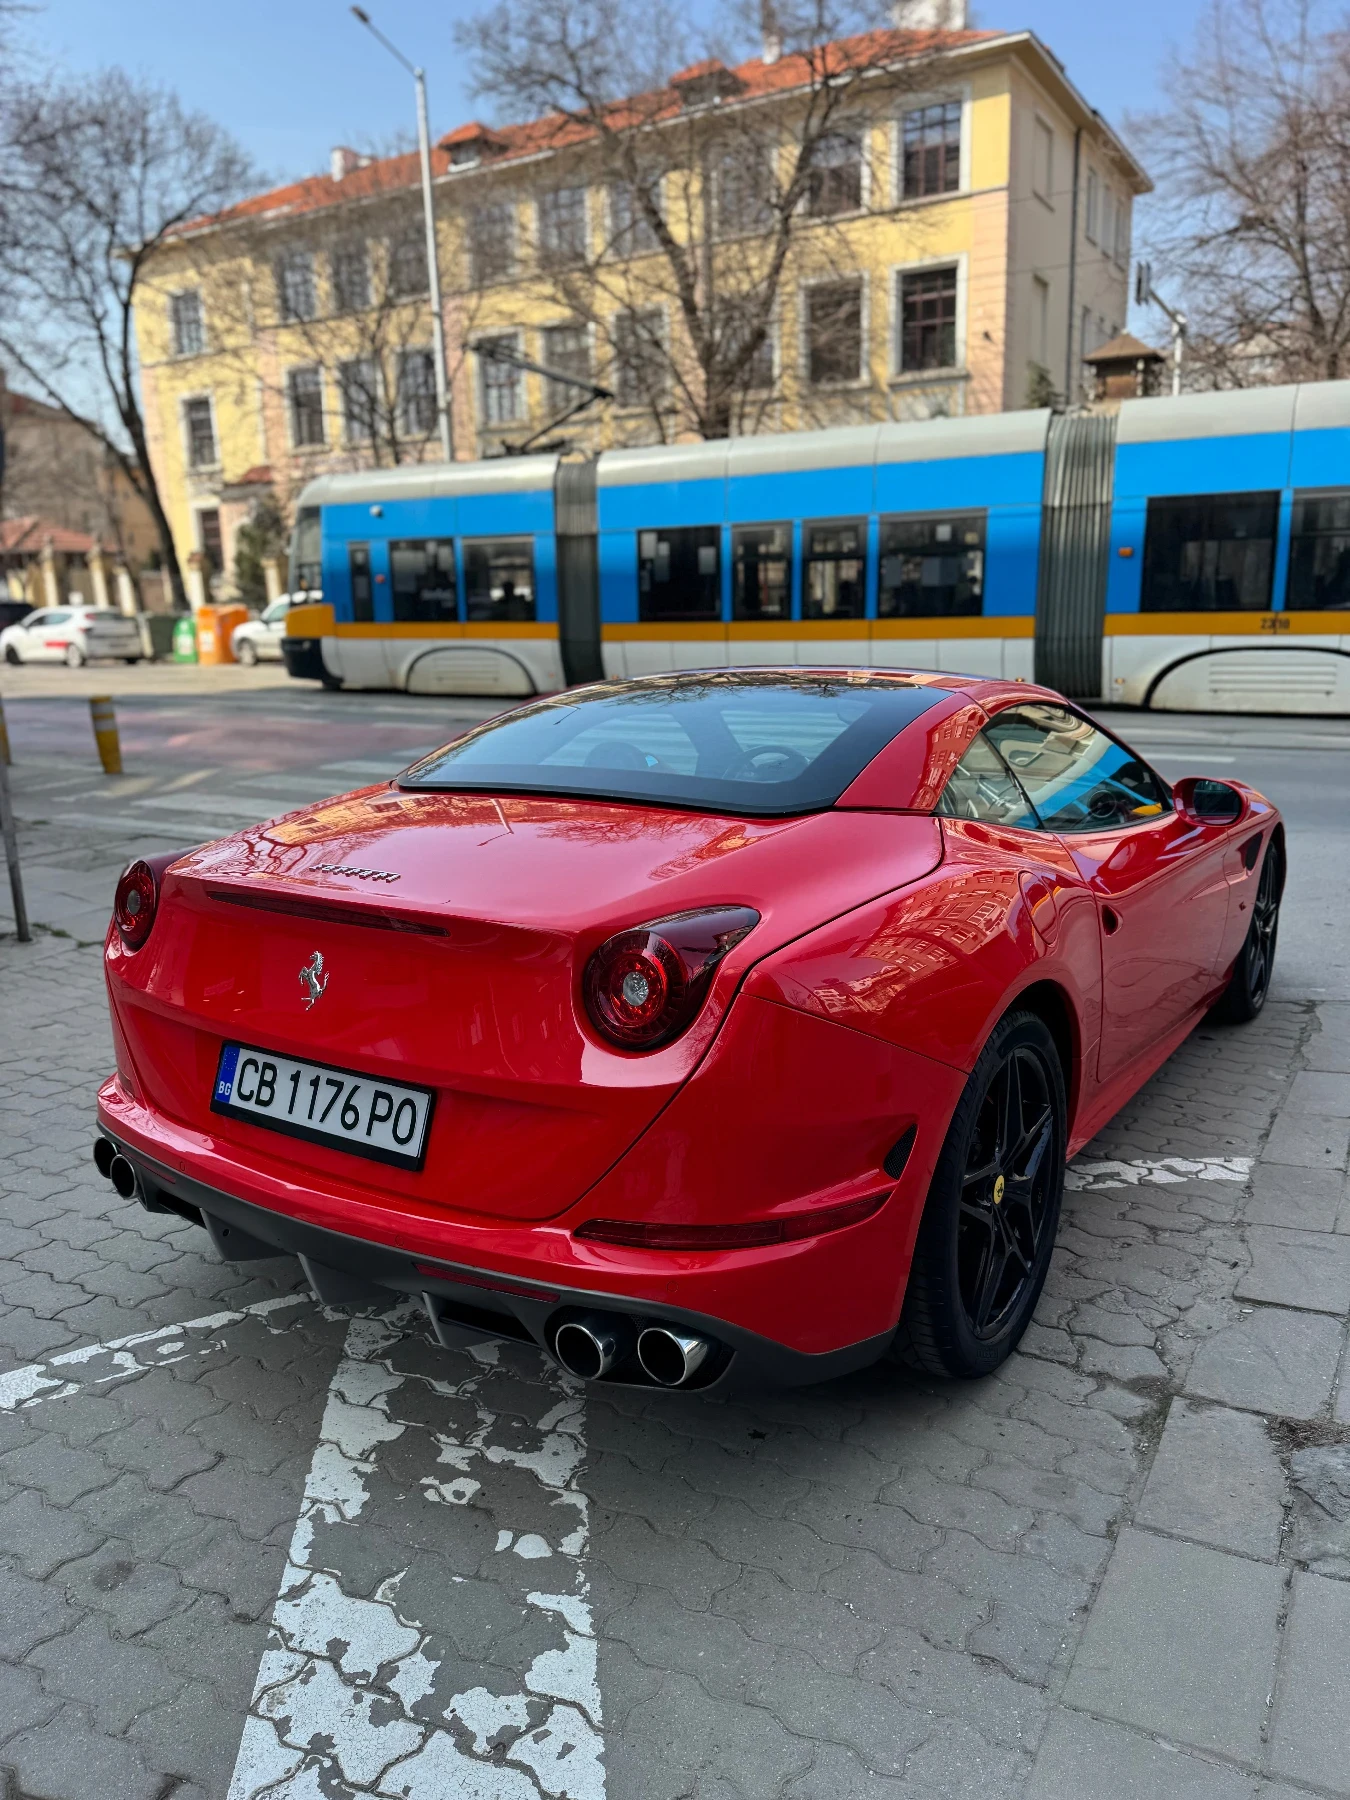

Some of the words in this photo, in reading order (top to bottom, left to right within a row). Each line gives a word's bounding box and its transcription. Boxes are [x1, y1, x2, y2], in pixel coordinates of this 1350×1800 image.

[218, 1080, 232, 1096] BG
[236, 1057, 278, 1108] CB
[287, 1069, 361, 1131] 1176
